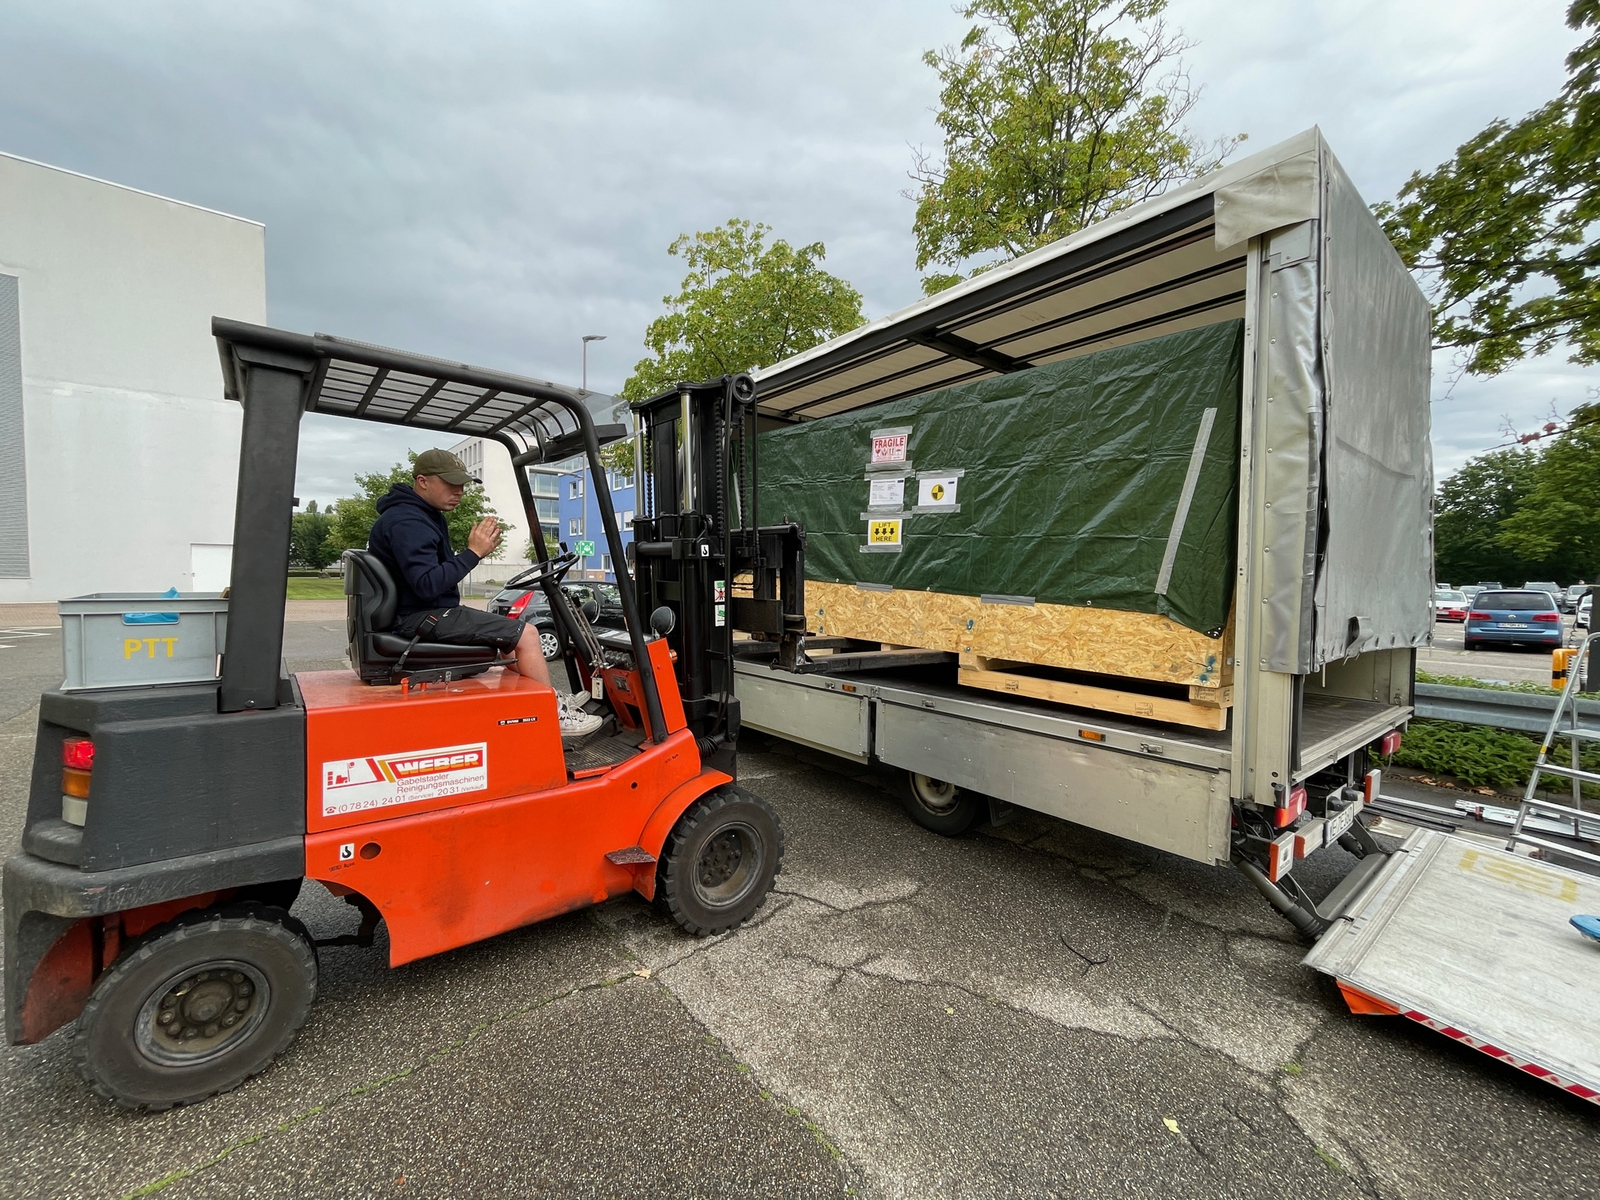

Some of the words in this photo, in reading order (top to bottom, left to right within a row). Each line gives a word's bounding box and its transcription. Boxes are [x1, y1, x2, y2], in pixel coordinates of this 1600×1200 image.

[874, 437, 904, 449] FRAGILE
[124, 637, 179, 660] PTT
[395, 753, 480, 776] WEBER
[396, 773, 449, 787] Gabelstapler
[396, 775, 485, 794] Reinigungsmaschinen
